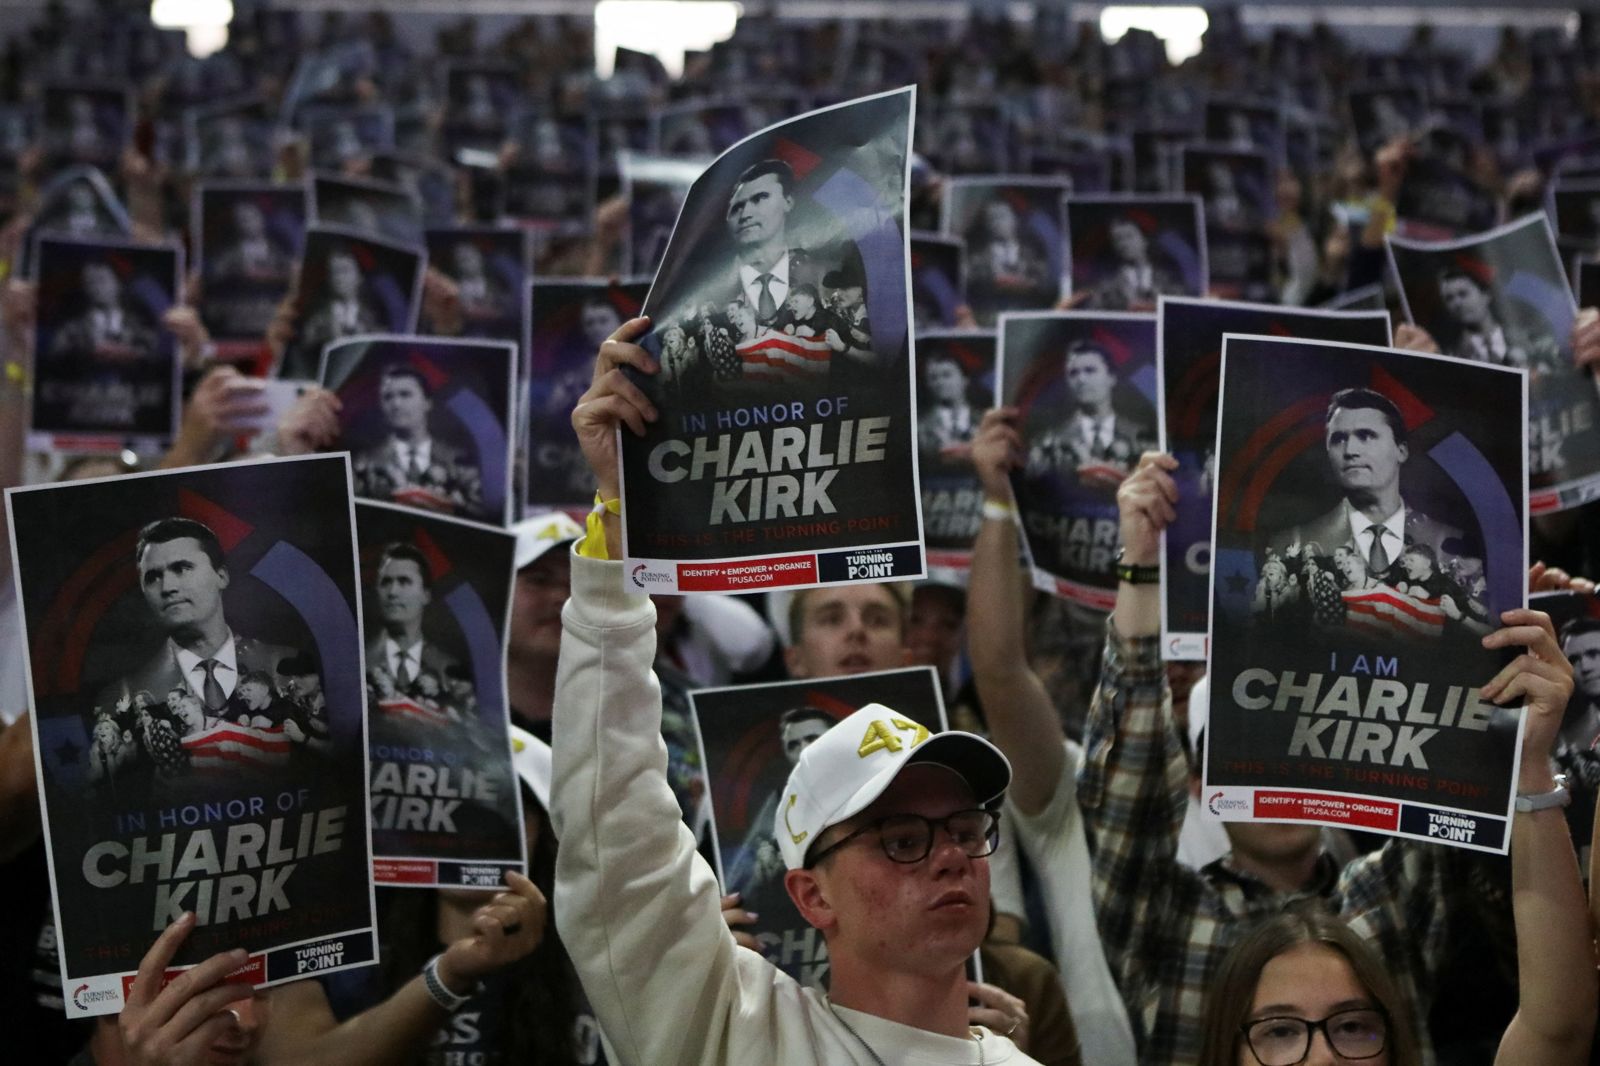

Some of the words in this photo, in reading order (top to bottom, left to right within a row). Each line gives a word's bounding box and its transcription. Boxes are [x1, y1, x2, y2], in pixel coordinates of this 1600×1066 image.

[683, 412, 706, 433] IN
[716, 402, 804, 428] HONOR
[816, 396, 849, 417] OF
[648, 416, 891, 483] CHARLIE
[709, 469, 840, 526] KIRK
[763, 520, 841, 539] TURNING
[847, 513, 900, 532] POINT
[682, 569, 720, 577] IDENTIFY
[727, 565, 768, 575] EMPOWER
[773, 561, 812, 571] ORGANIZE
[845, 553, 894, 566] TURNING
[848, 563, 894, 579] POINT
[728, 574, 774, 584] TPUSA.COM
[1330, 652, 1337, 672] I
[1351, 654, 1399, 677] AM
[1232, 668, 1491, 732] CHARLIE
[857, 719, 929, 758] 47
[1288, 716, 1439, 770] KIRK
[370, 761, 498, 800] ARLIE
[1344, 768, 1429, 790] TURNING
[1436, 778, 1489, 797] POINT
[115, 812, 145, 832] IN
[160, 796, 264, 828] HONOR
[277, 788, 311, 812] OF
[1259, 796, 1296, 805] IDENTIFY
[1303, 799, 1345, 809] EMPOWER
[1351, 804, 1394, 816] ORGANIZE
[1303, 807, 1350, 818] TPUSA.COM
[1428, 813, 1476, 829] TURNING
[1428, 823, 1476, 843] POINT
[82, 805, 348, 888] CHARLIE
[153, 863, 298, 931] KIRK
[295, 942, 344, 960] TURNING
[297, 952, 344, 973] POINT
